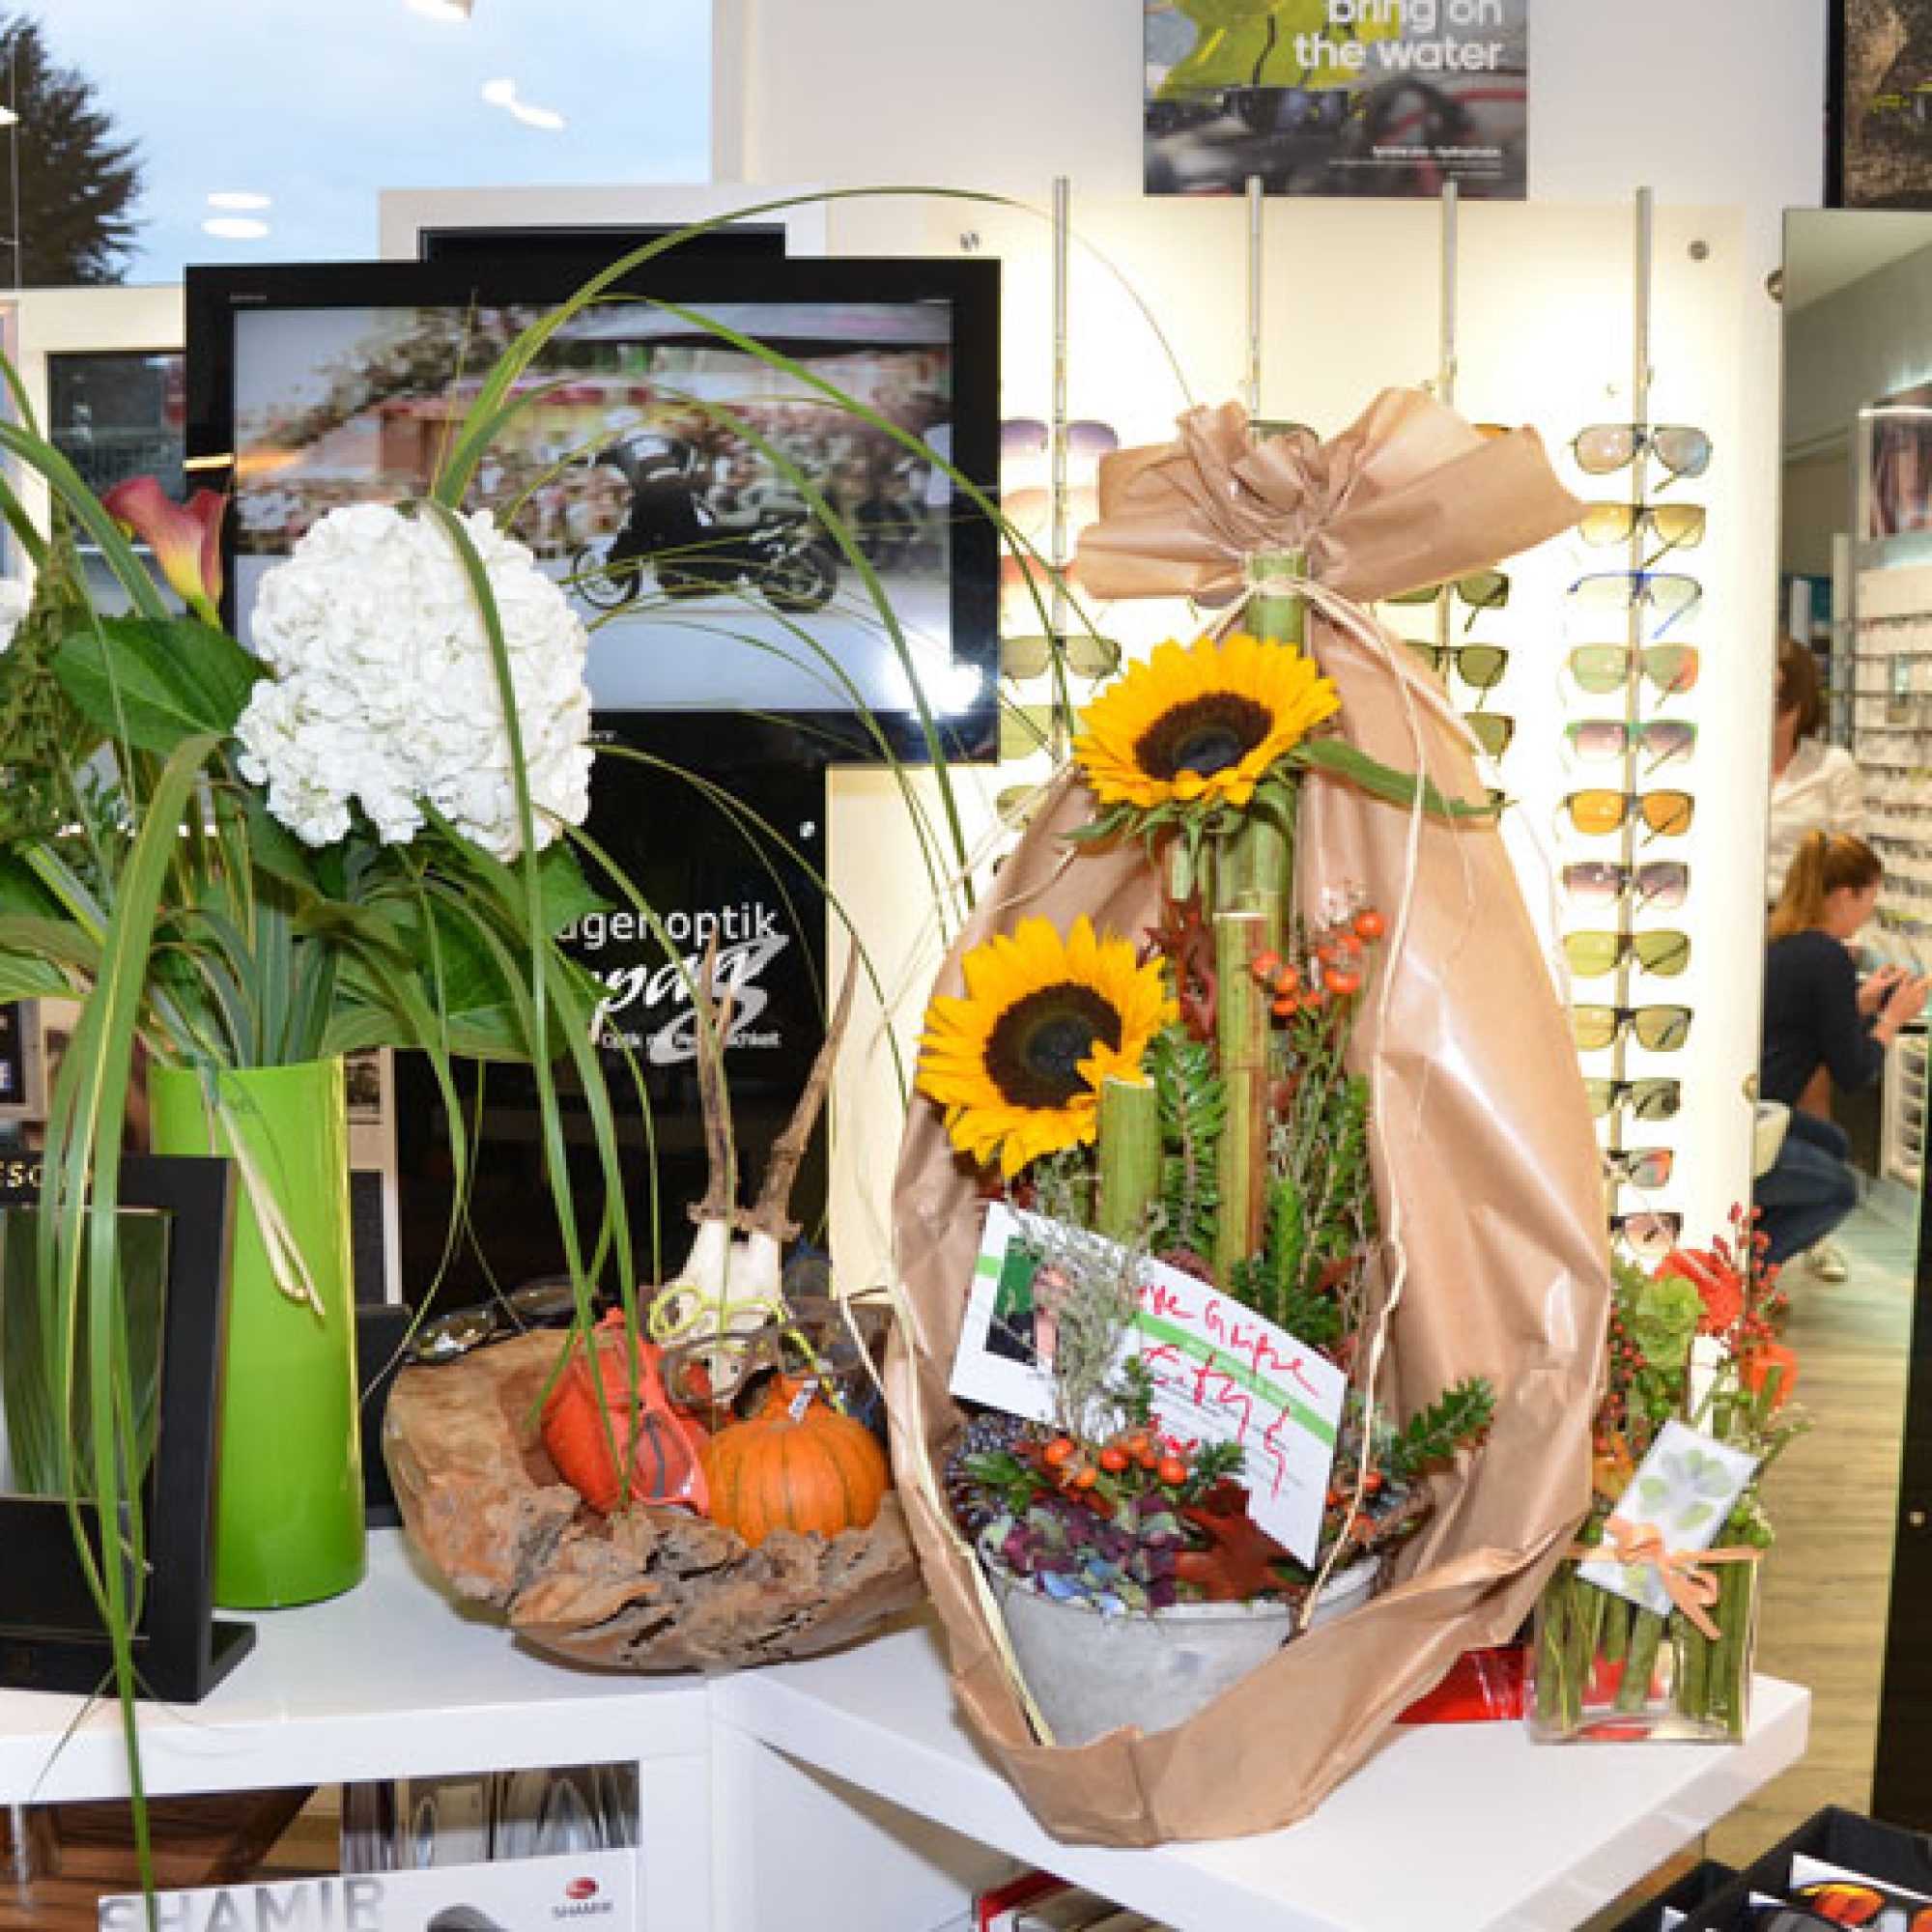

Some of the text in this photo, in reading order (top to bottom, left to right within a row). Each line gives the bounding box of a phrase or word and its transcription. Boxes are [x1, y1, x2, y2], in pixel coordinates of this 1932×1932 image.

[1328, 0, 1503, 34] bring on
[1293, 32, 1505, 71] the water
